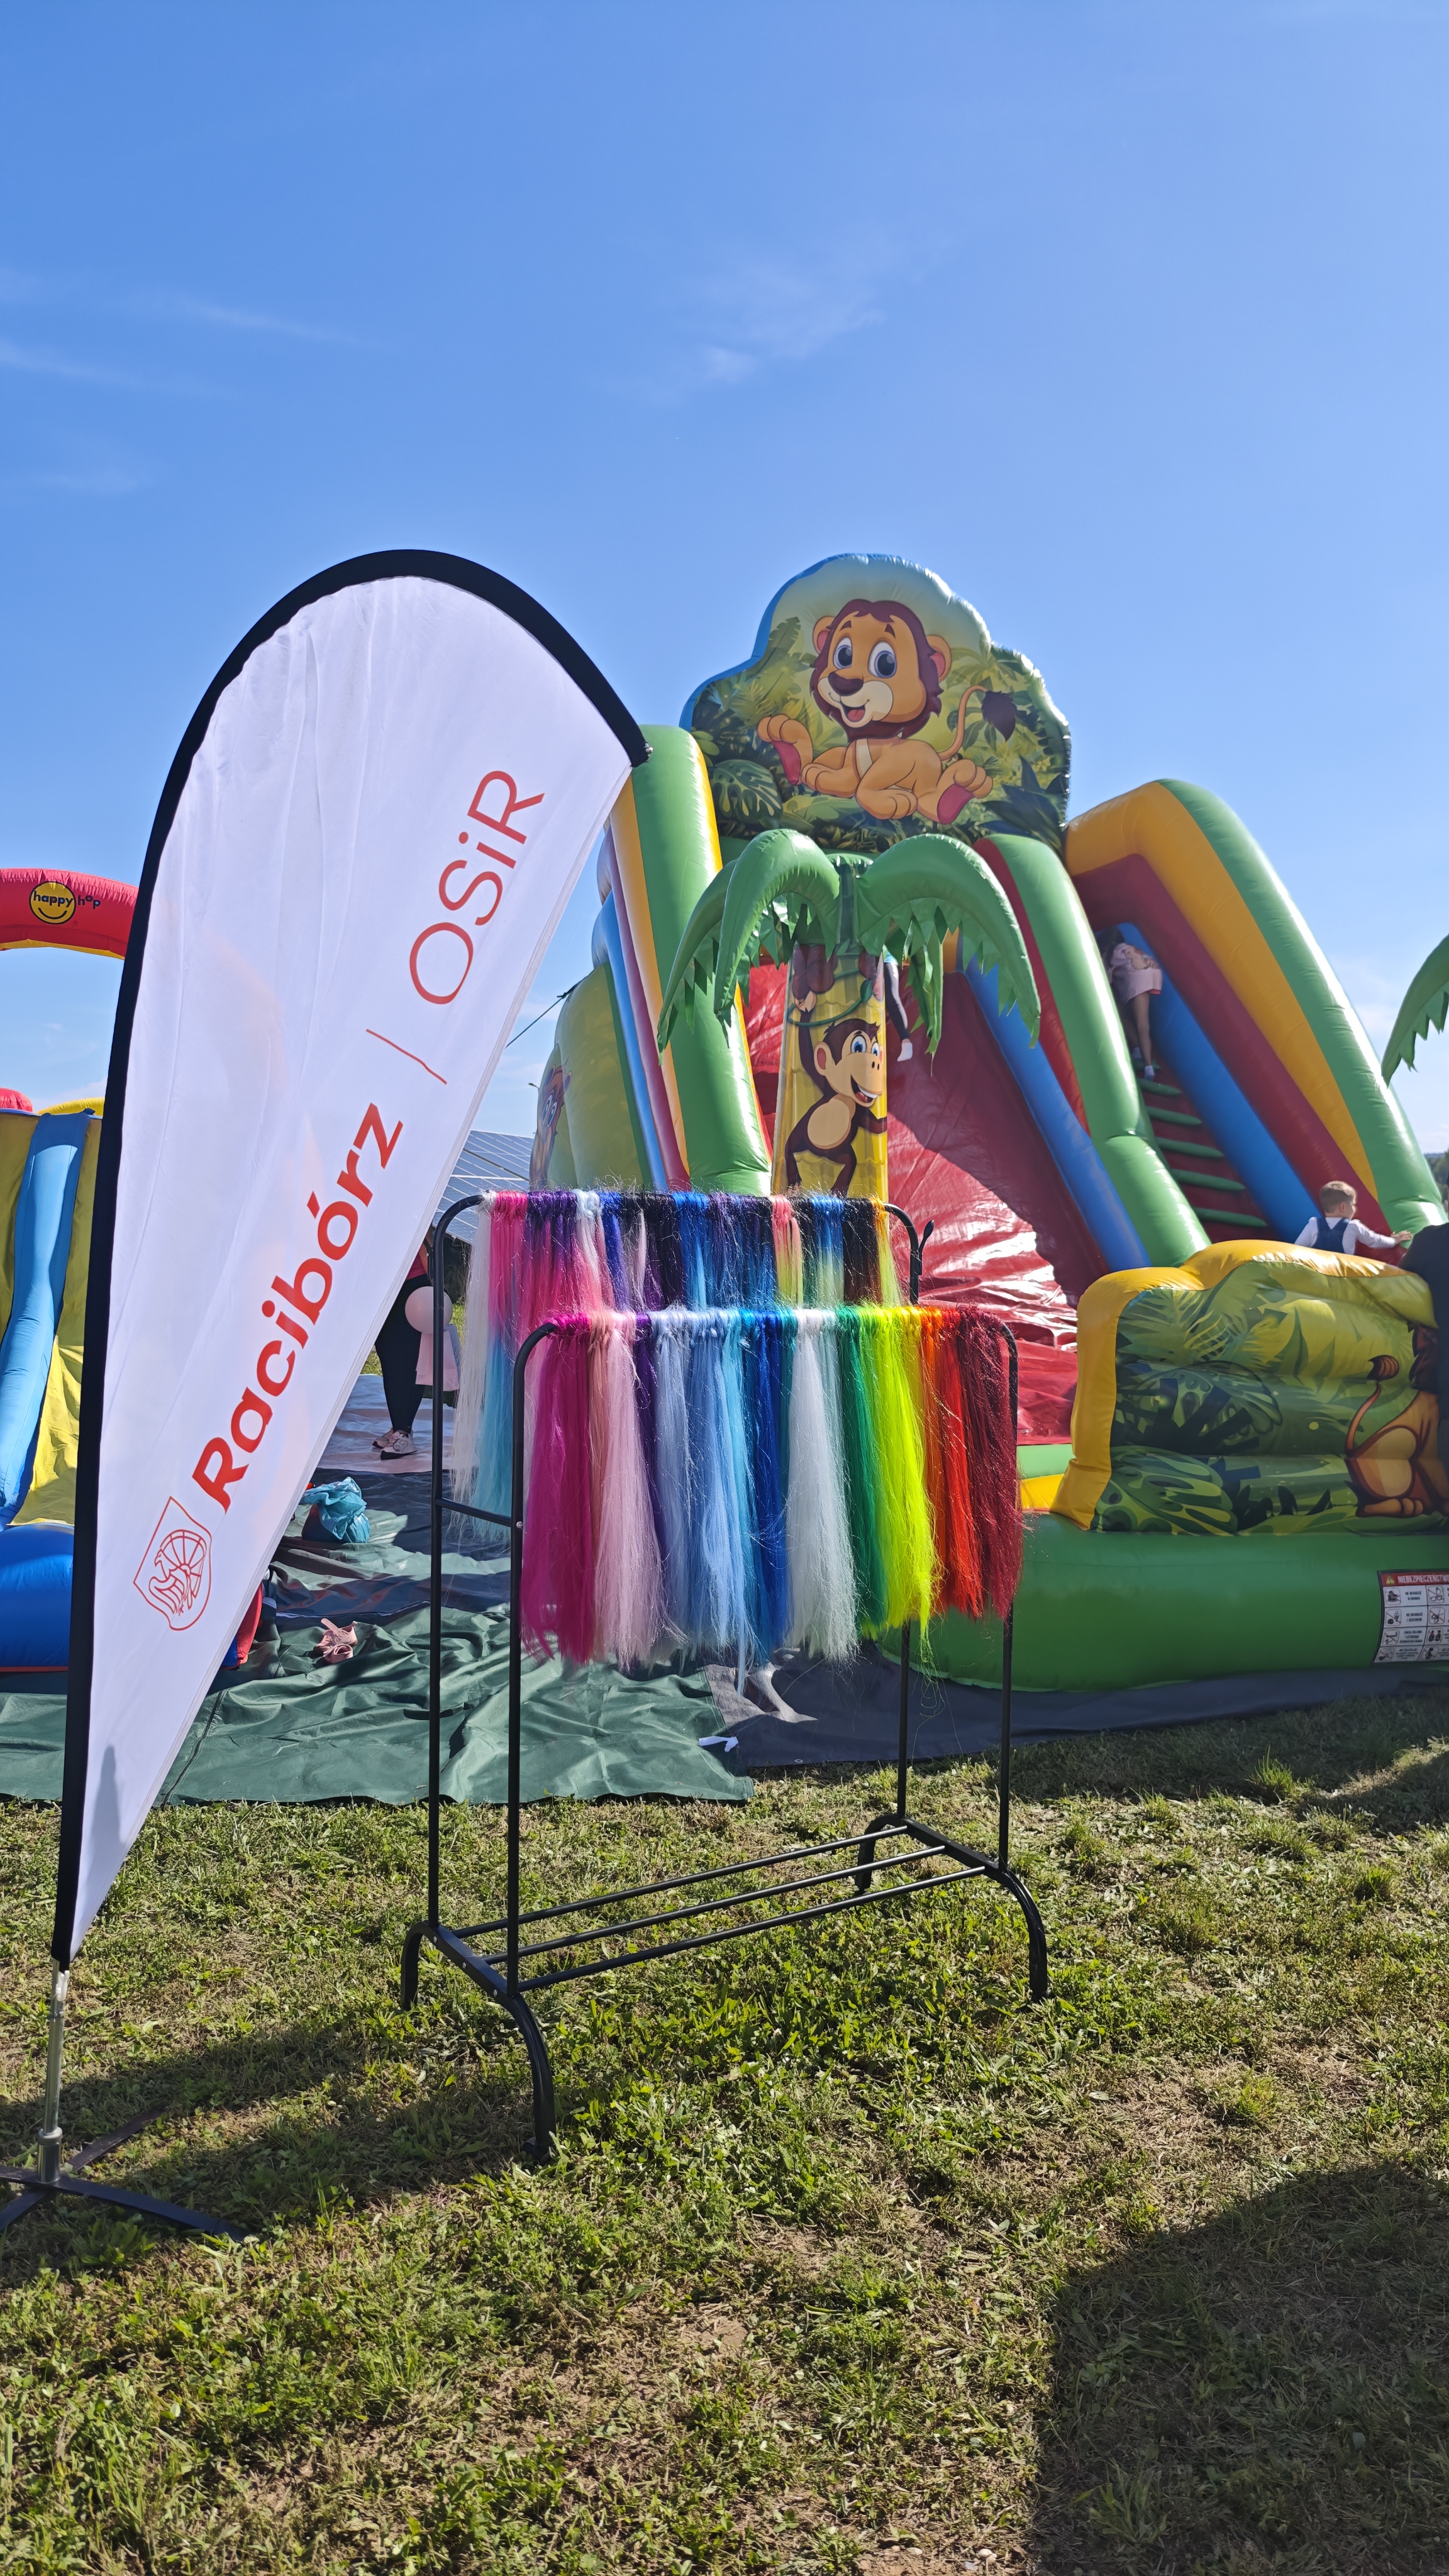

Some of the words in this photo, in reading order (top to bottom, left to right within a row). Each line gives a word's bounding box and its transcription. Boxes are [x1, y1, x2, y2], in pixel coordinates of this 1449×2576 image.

[33, 891, 74, 908] happy
[78, 895, 101, 909] hop
[192, 1104, 403, 1513] Racibórz
[410, 771, 544, 1004] OSiR
